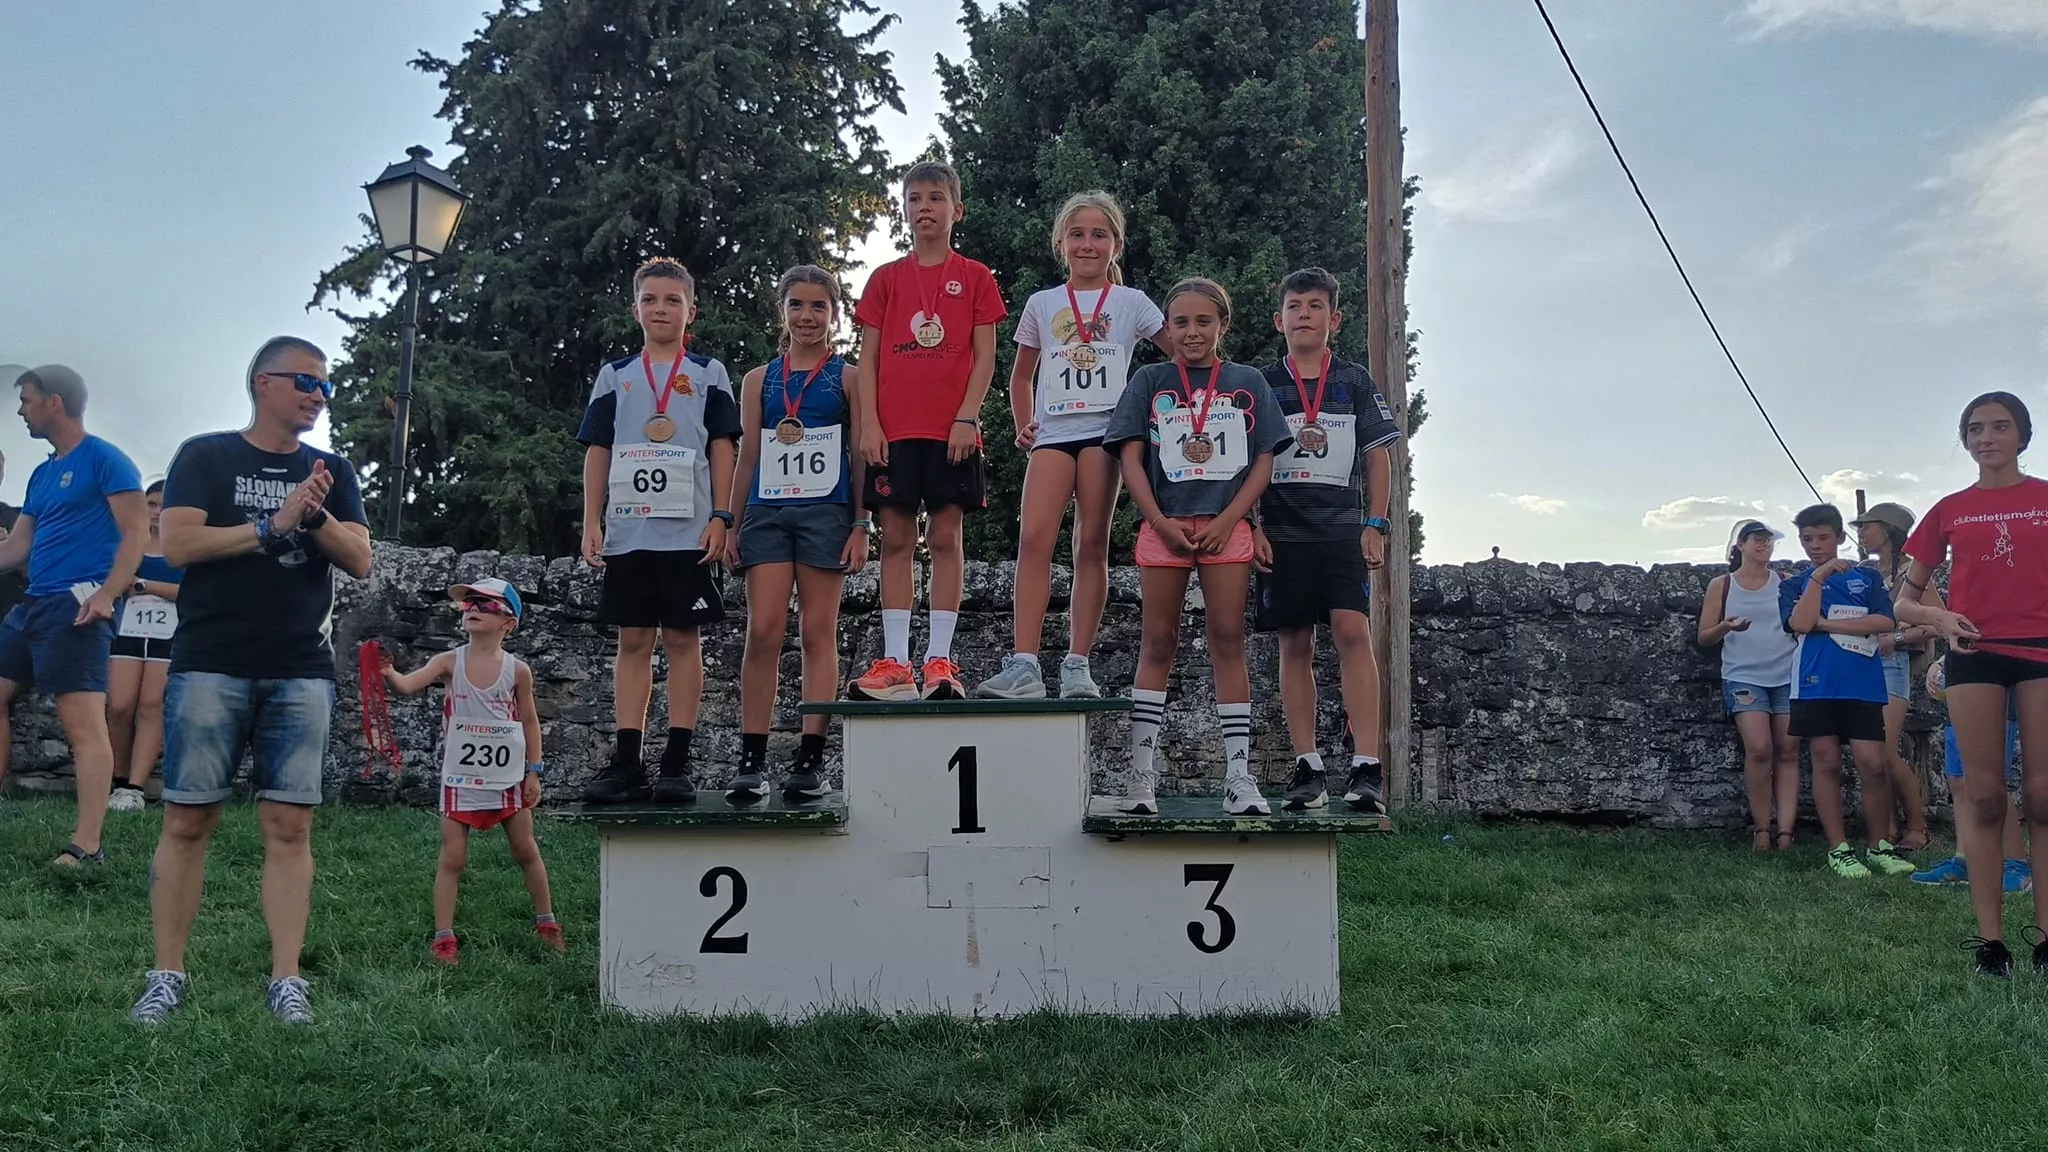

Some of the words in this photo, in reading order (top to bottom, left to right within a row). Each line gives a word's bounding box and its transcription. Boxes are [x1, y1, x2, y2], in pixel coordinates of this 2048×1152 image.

[1059, 366, 1107, 390] 101
[627, 449, 687, 458] INTERSPORT
[1176, 431, 1226, 456] 11
[778, 452, 826, 475] 116
[633, 468, 668, 493] 69
[136, 610, 167, 625] 112
[459, 743, 510, 767] 230
[947, 745, 987, 834] 1
[698, 866, 750, 954] 2
[1183, 863, 1236, 954] 3
